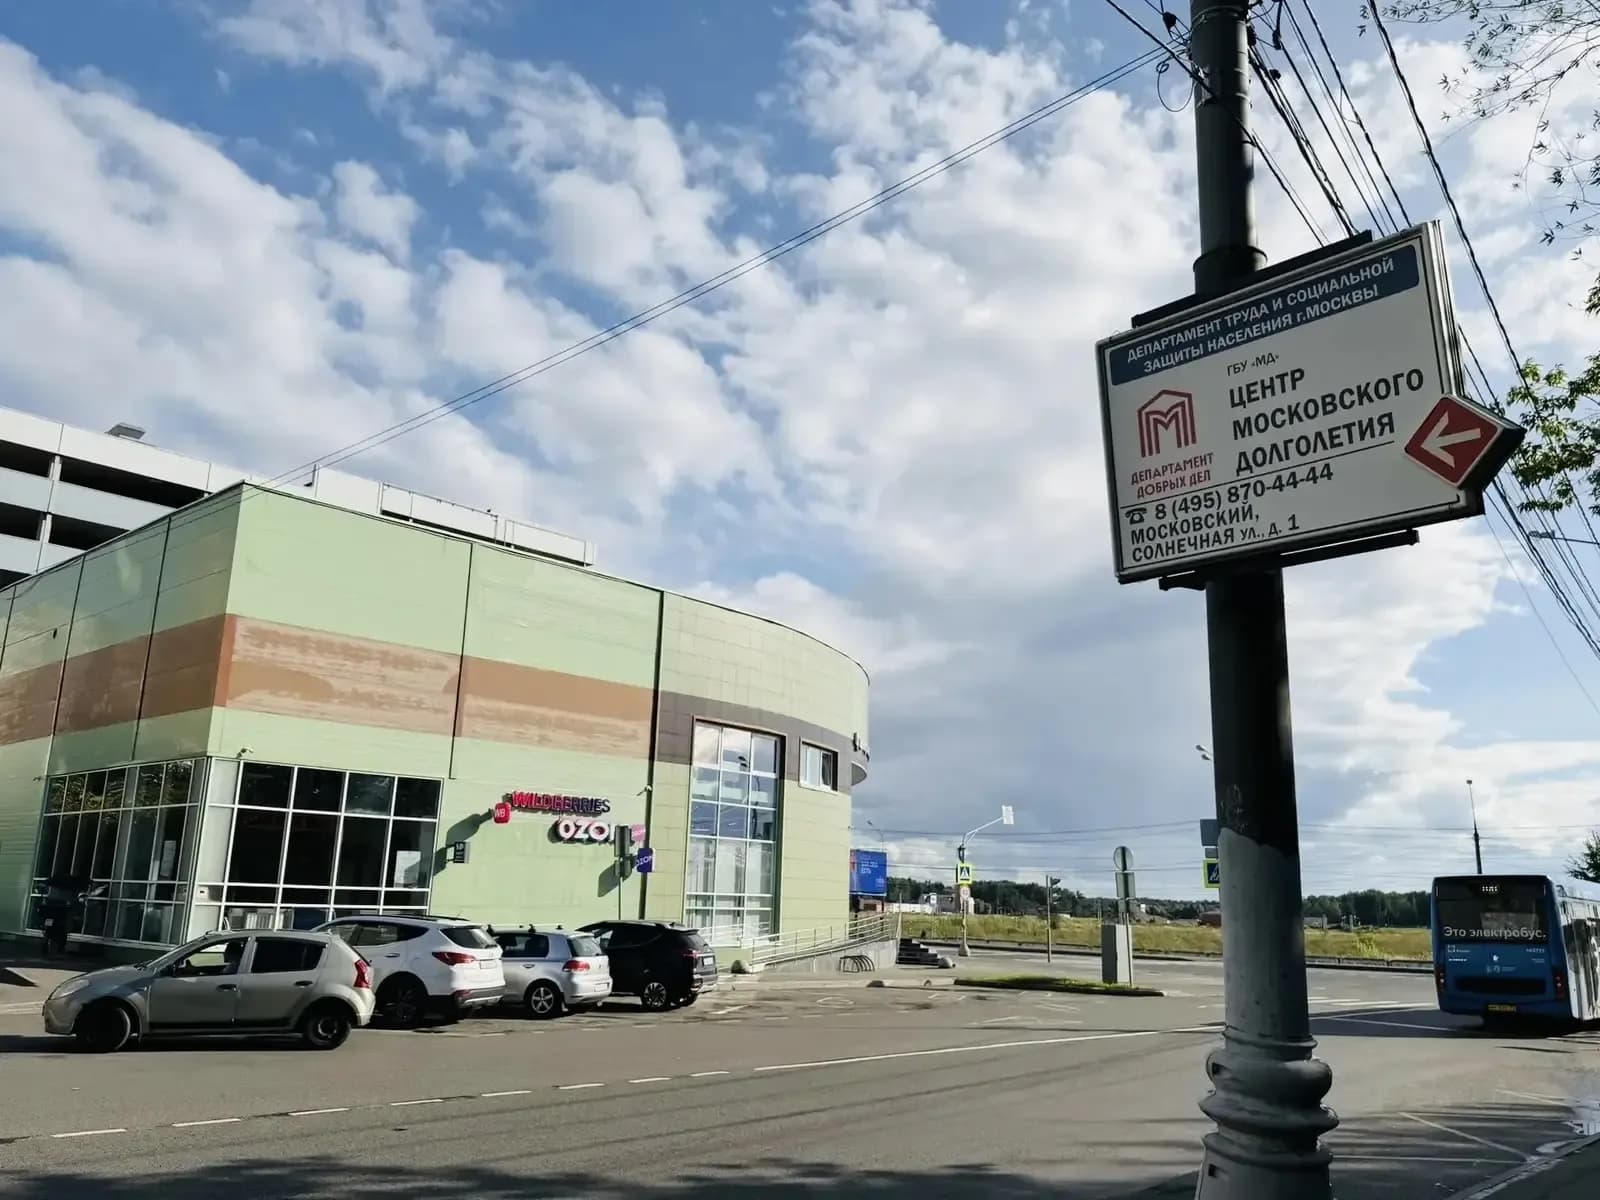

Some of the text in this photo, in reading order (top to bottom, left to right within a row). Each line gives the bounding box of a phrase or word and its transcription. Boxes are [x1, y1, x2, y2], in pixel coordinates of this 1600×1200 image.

[1128, 256, 1395, 363] ДЕПАРТАМЕНТ ТРУДА И СОЦИАЛЬНОЙ
[1144, 284, 1379, 373] ЗАЩИТЫ НАСЕЛЕНИЯ г.МОСКВЫ
[1226, 360, 1248, 376] ГБУ
[1229, 368, 1305, 409] ЦЕНТР
[1232, 368, 1424, 441] МОСКОВСКОГО
[1236, 411, 1395, 477] ДОЛГОЛЕТИЯ
[1131, 452, 1214, 486] ДЕПАРТАМЕНТ
[1137, 469, 1211, 499] ДОБРЫХ ДЕЛ
[1155, 463, 1334, 520] 8 (495) 870-44-44
[1130, 501, 1260, 545] МОСКОВСКИЙ,
[1132, 528, 1235, 562] СОЛНЕЧНАЯ
[1287, 514, 1300, 531] 1
[512, 791, 611, 814] WILDBERRIES
[1444, 926, 1546, 940] Это электробус.
